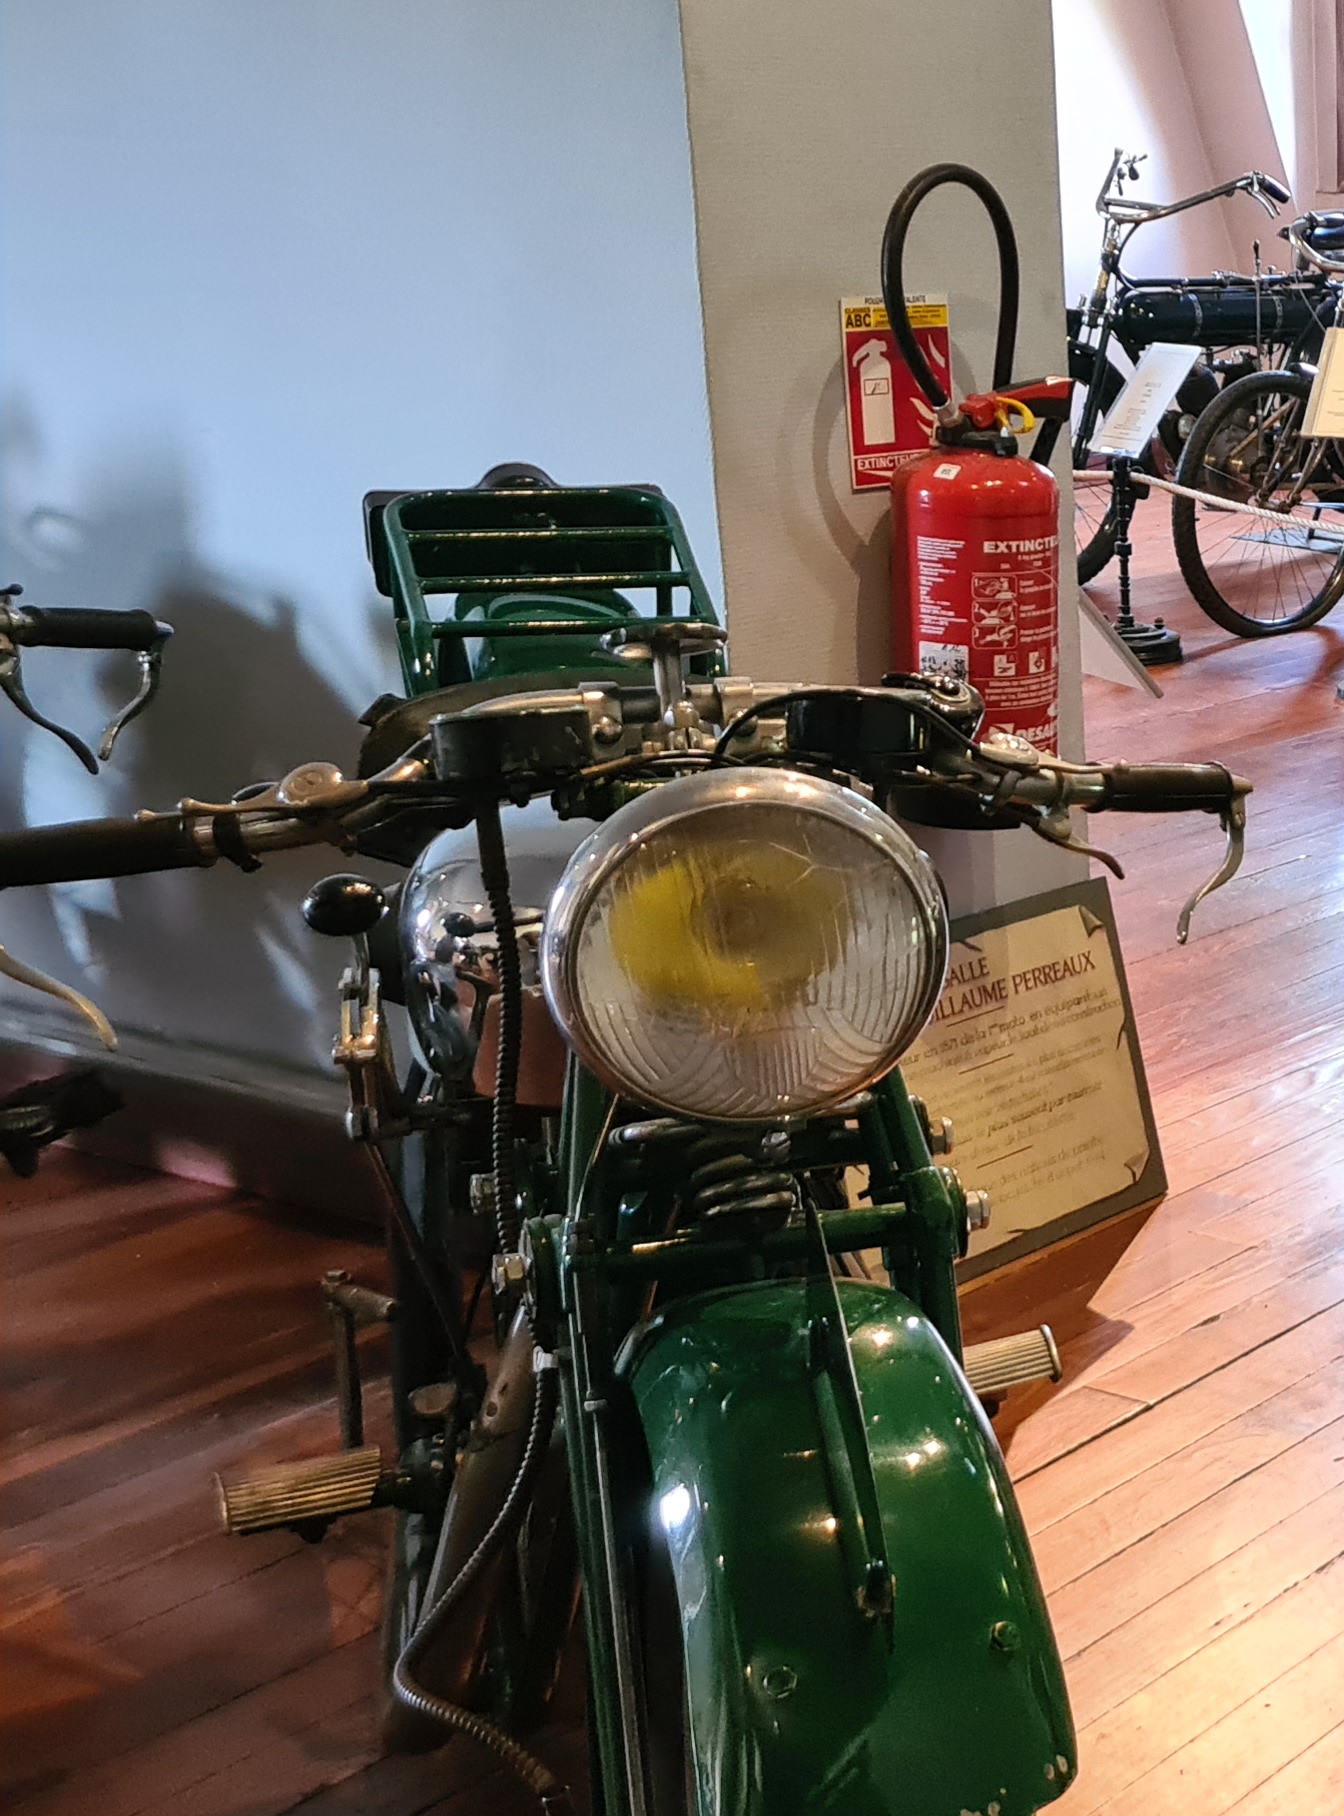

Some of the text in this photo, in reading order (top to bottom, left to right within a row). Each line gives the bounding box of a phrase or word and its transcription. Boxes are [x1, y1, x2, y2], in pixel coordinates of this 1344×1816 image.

[845, 313, 872, 329] ABC
[983, 534, 1057, 554] EXTINCTE
[932, 950, 1096, 1022] ILLAUME PERREAUX
[998, 1013, 1026, 1034] moto
[1029, 1009, 1043, 1023] en
[1043, 990, 1093, 1018] équipant
